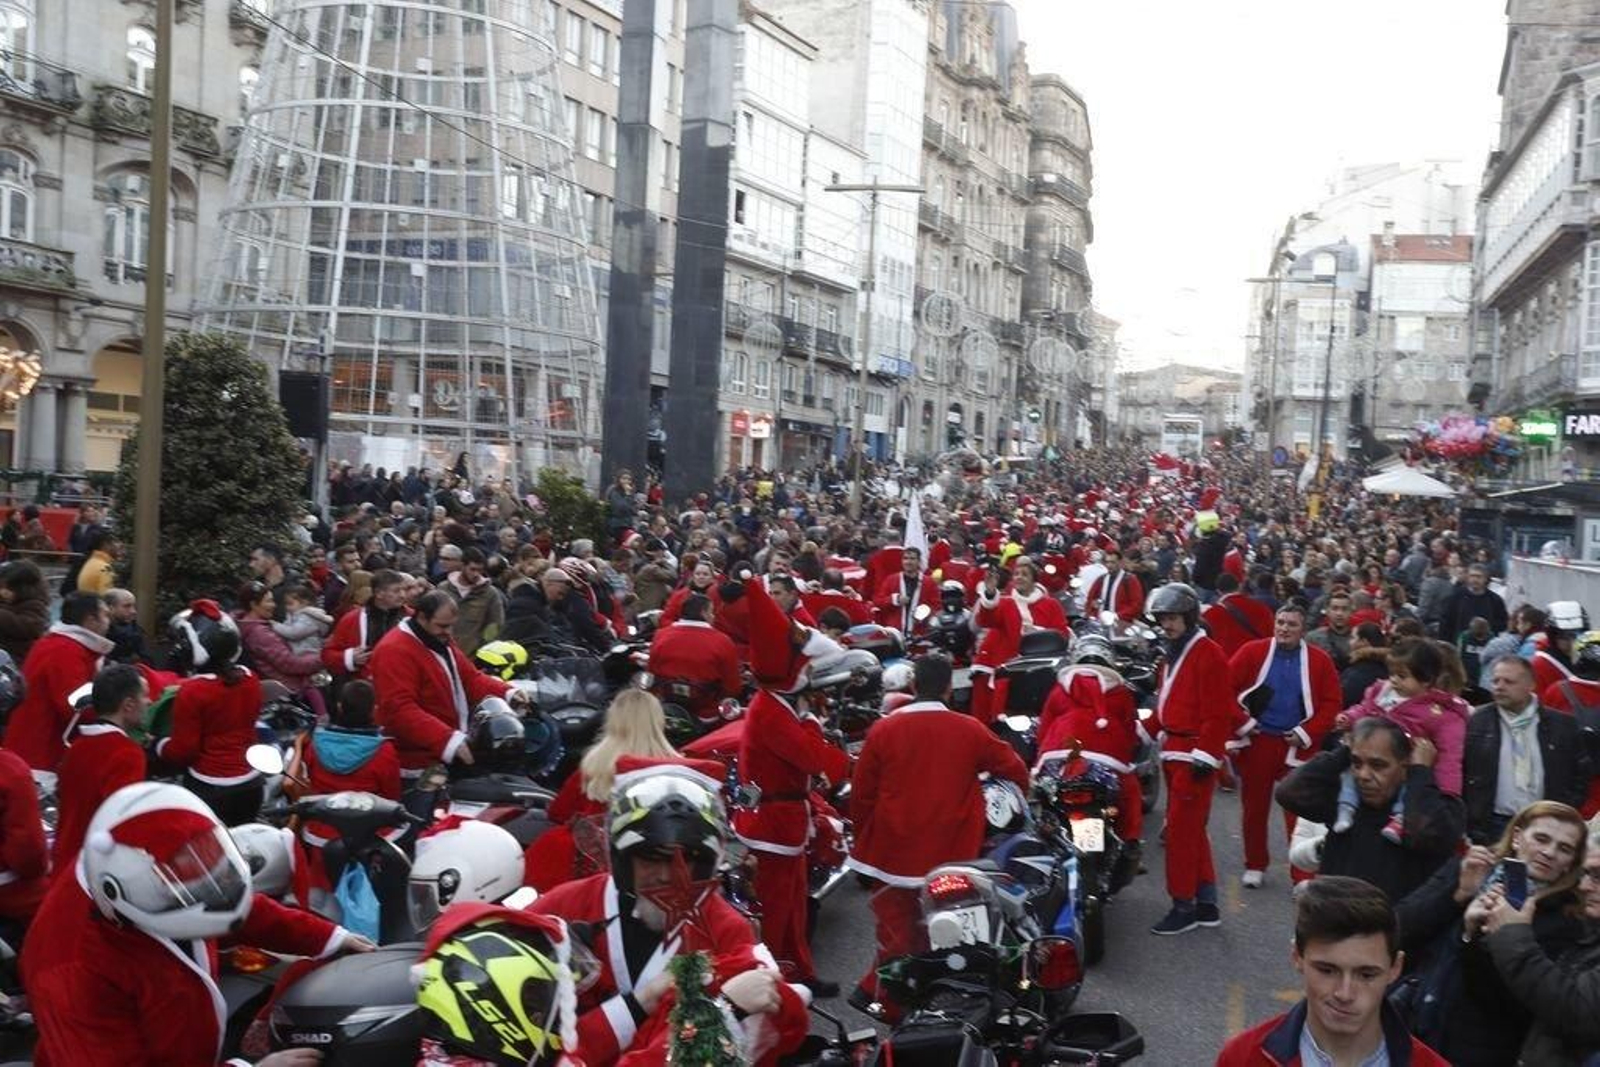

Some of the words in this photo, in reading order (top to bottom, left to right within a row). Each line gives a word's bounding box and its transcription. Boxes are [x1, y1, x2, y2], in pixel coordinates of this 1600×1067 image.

[1565, 414, 1600, 435] FAR
[453, 981, 529, 1044] LS2
[290, 1033, 333, 1044] SHAD
